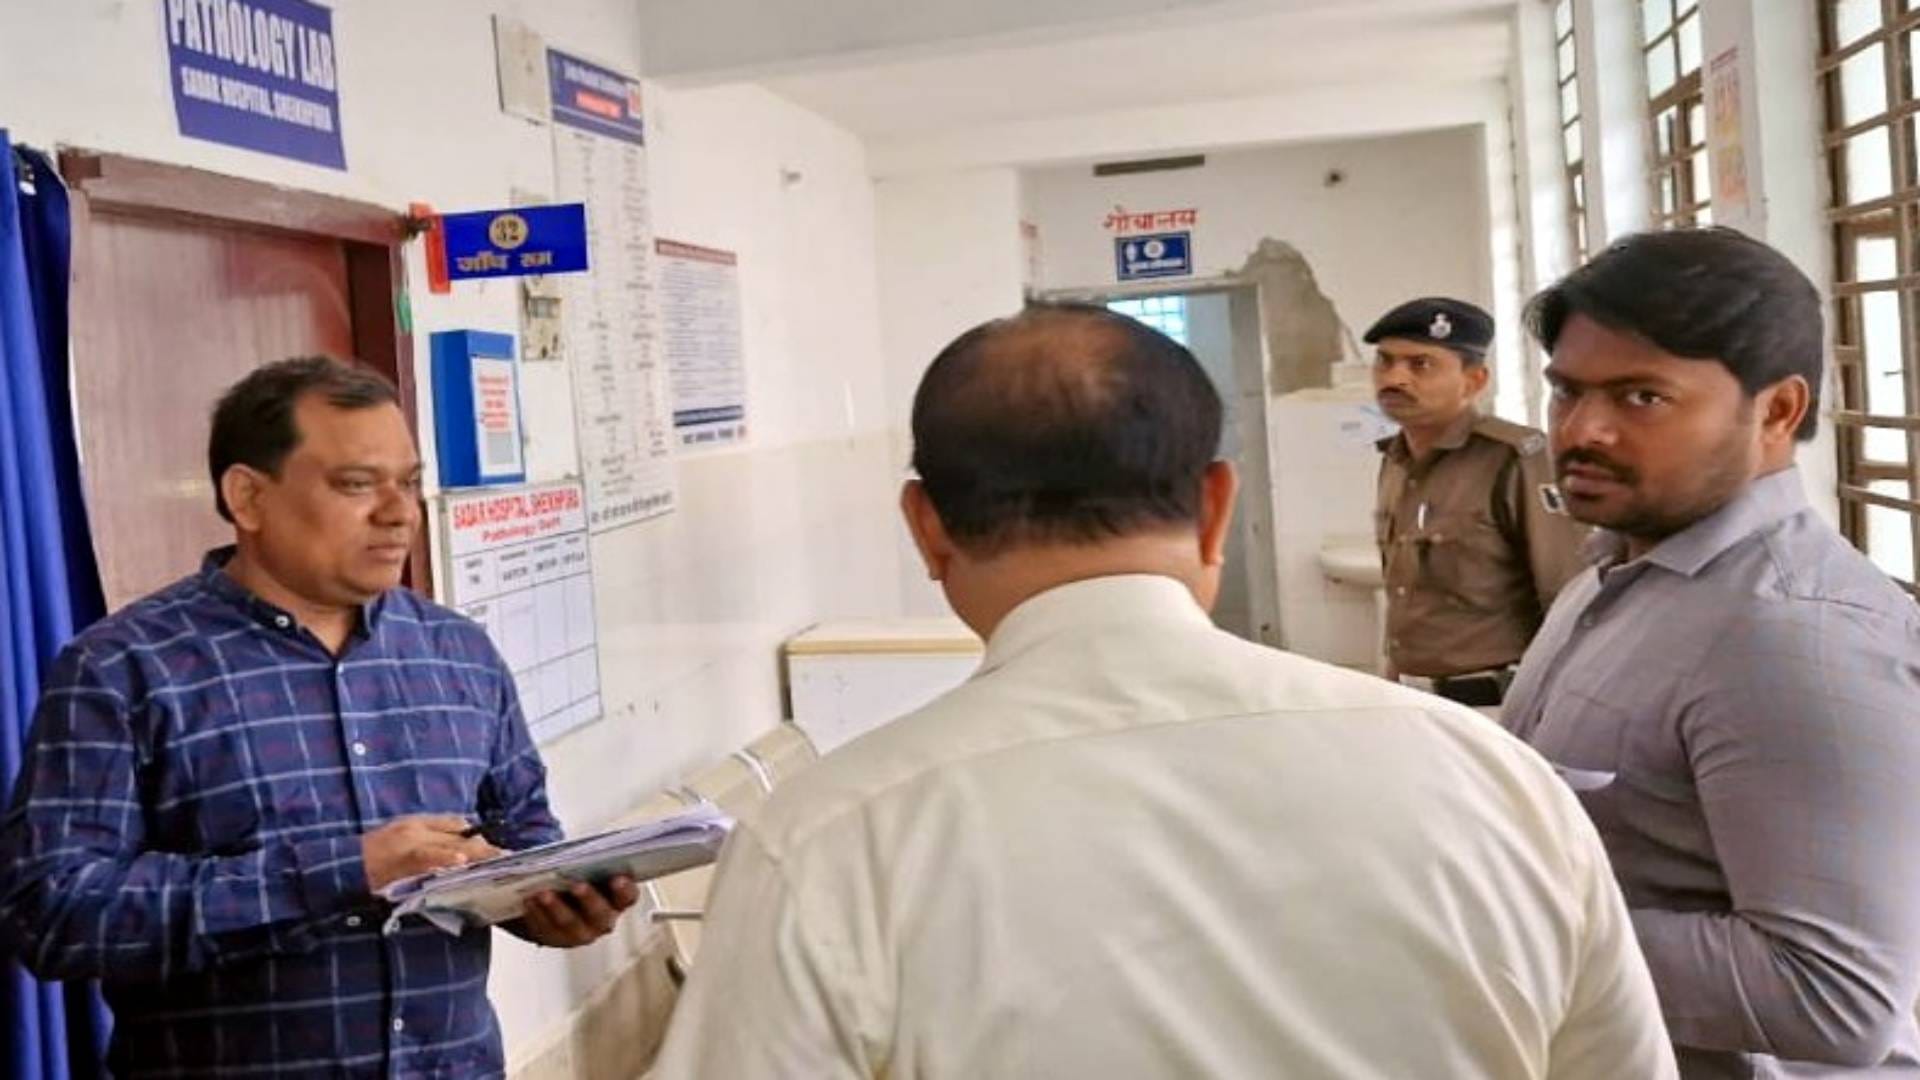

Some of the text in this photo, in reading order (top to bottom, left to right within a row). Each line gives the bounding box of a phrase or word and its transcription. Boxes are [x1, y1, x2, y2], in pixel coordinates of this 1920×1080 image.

[166, 0, 335, 92] PATHOLOGY LAB
[496, 218, 519, 241] 32
